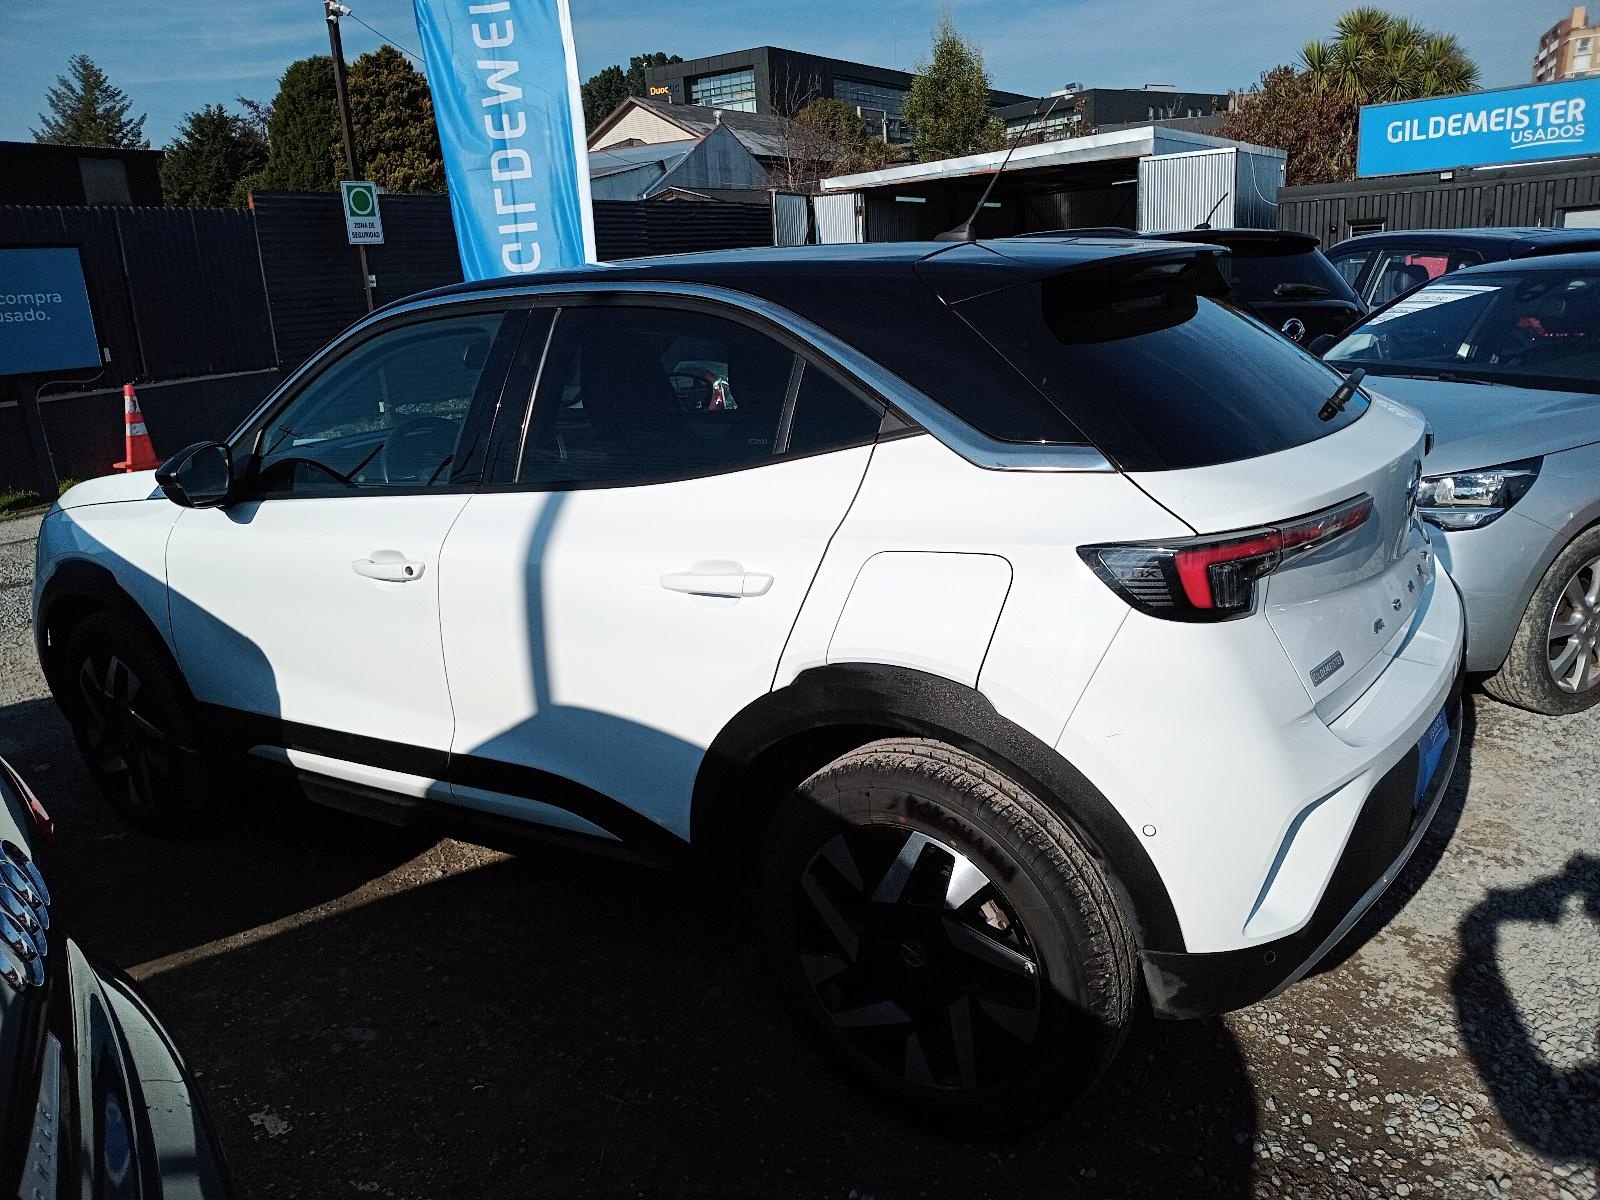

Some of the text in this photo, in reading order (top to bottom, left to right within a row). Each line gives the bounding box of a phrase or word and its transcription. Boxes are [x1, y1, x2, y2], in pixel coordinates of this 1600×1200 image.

[650, 86, 669, 96] Duoc
[1387, 97, 1586, 144] GILDEMEISTER
[1510, 123, 1585, 144] USADOS
[351, 231, 381, 239] SEGURIDAD
